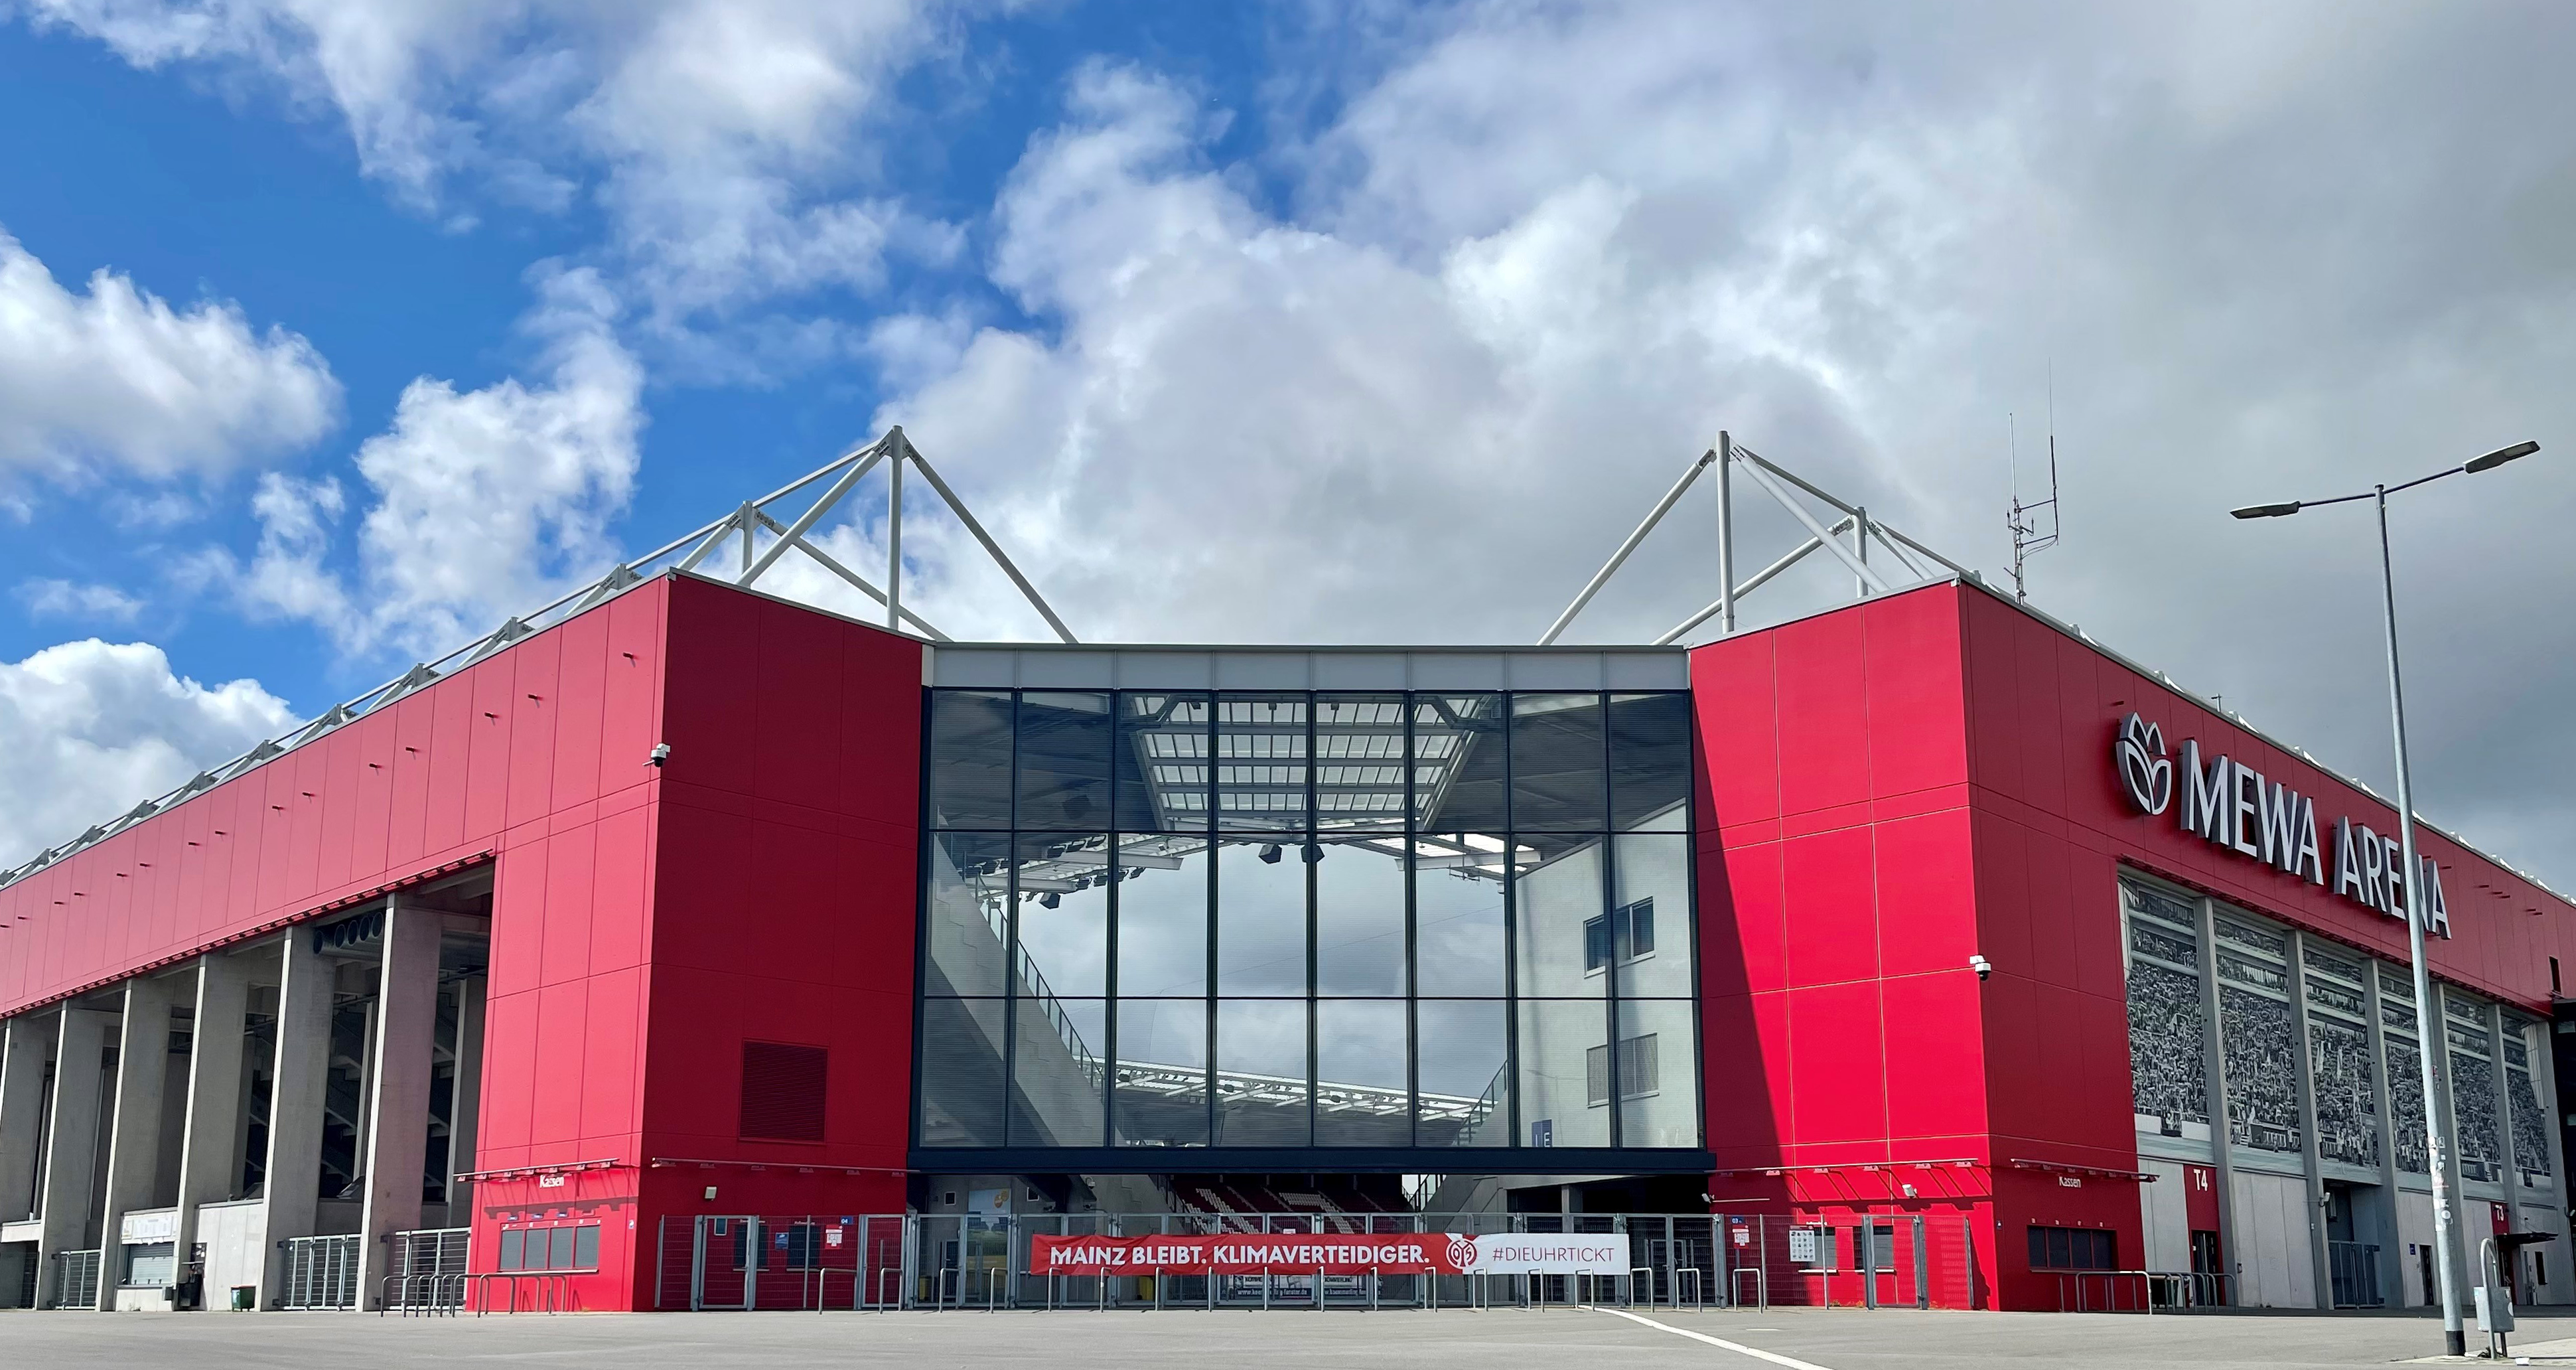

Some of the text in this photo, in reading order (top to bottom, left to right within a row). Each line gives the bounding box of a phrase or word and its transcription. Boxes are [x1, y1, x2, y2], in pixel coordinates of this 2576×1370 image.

[2182, 739, 2324, 885] MEWA
[539, 1174, 564, 1188] Kassen
[2058, 1176, 2082, 1188] Kassen
[2193, 1168, 2208, 1191] T4
[1050, 1245, 1429, 1265] MAINZ BLEIBT. KLIMAVERTEIDIGER.
[1492, 1247, 1614, 1262] #DIEUHRTICKT
